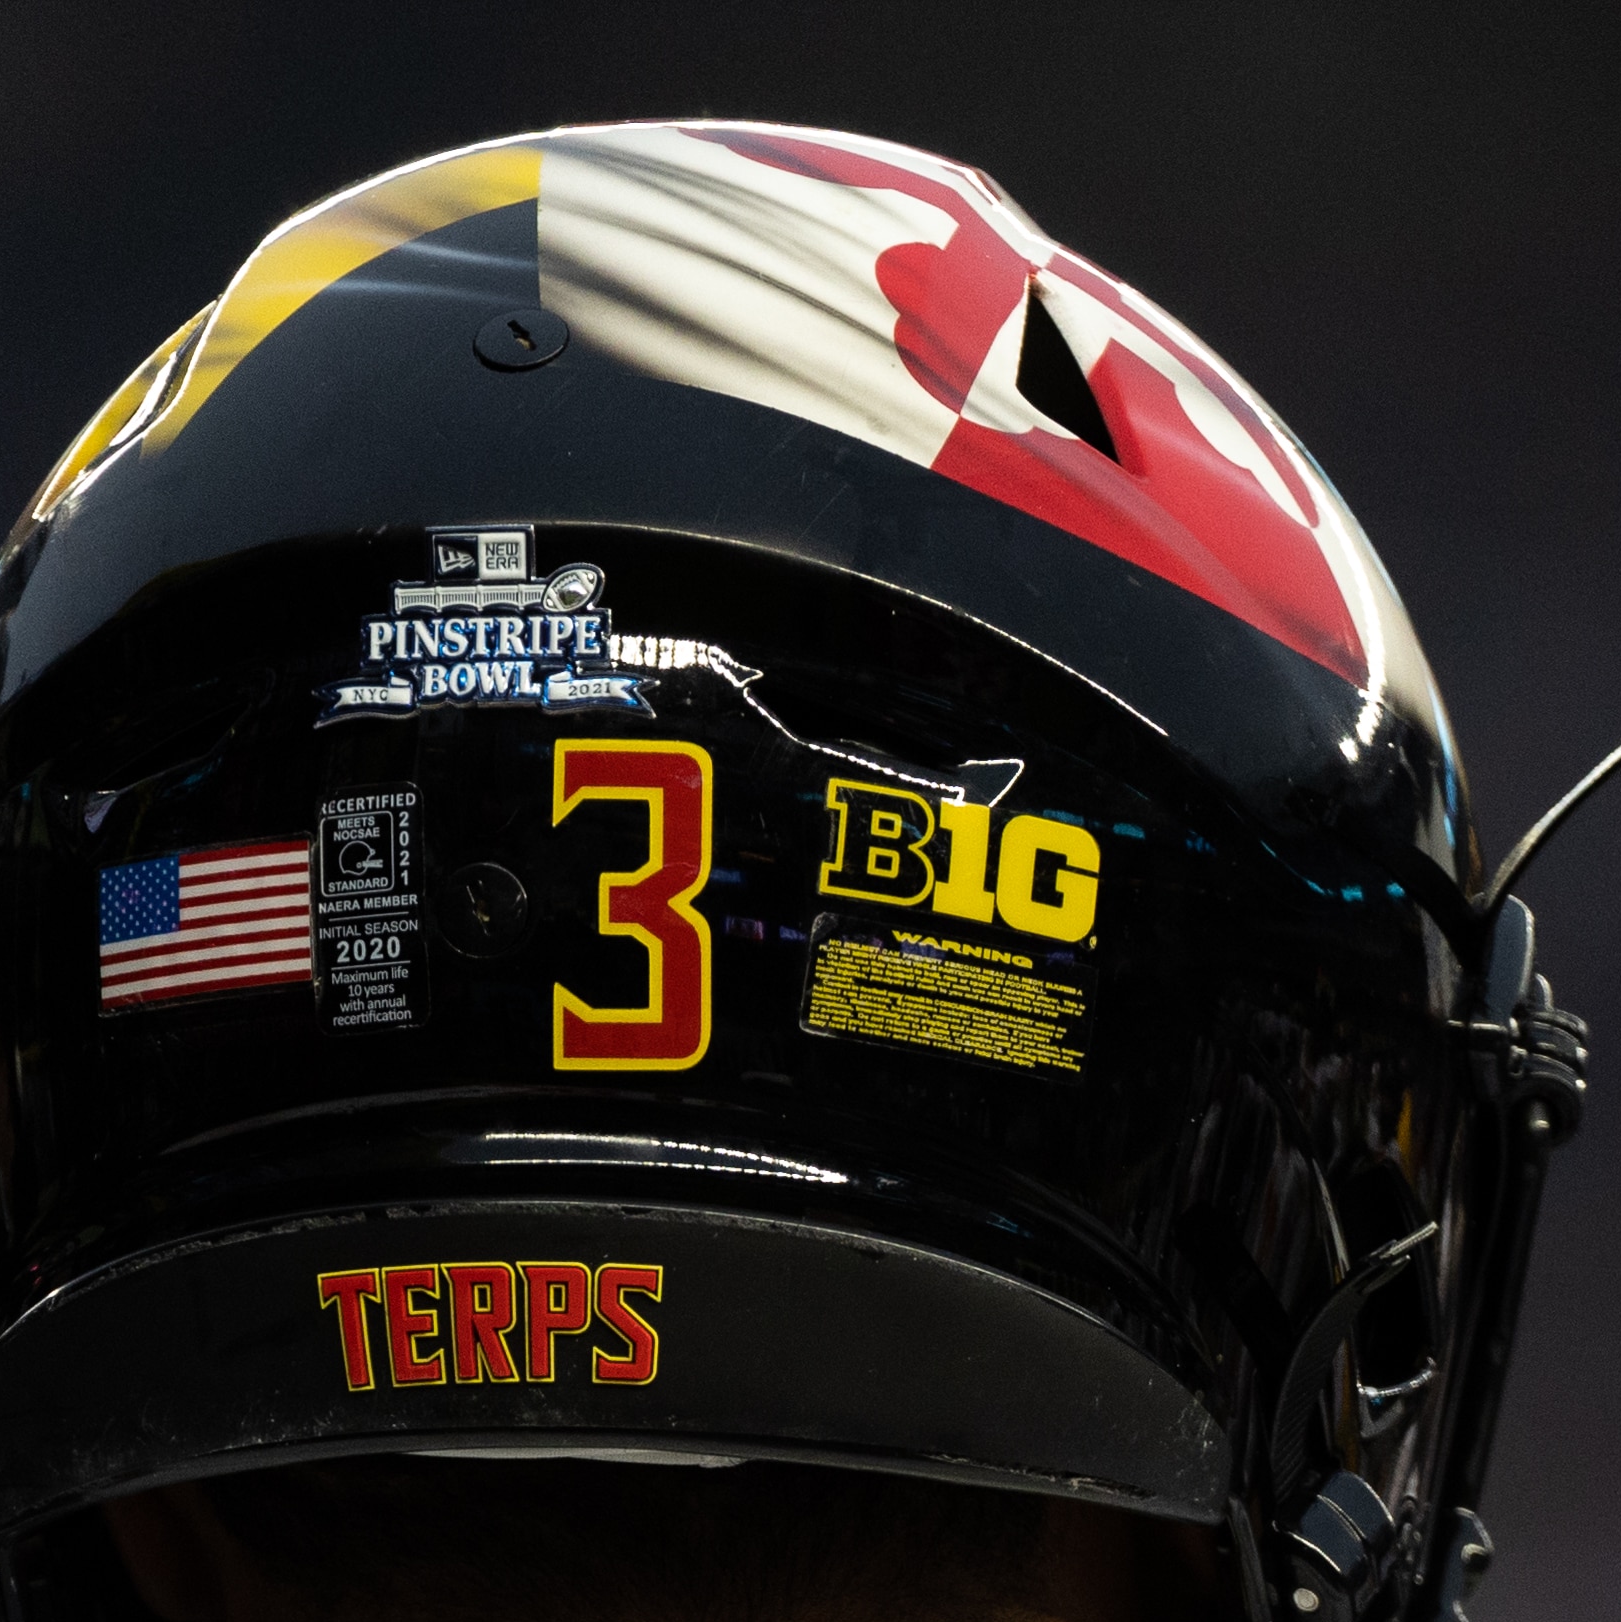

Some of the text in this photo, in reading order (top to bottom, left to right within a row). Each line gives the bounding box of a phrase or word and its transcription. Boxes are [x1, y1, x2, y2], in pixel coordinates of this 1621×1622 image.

[485, 543, 520, 556] NEW
[485, 557, 519, 570] ERA
[368, 615, 601, 661] PINSTRIPE
[423, 660, 542, 698] BOWL
[352, 688, 390, 702] NYC
[567, 682, 613, 698] 2021
[337, 815, 376, 830] MEETS
[333, 826, 381, 842] NOCSAE
[328, 876, 390, 893] STANDARD
[318, 894, 419, 914] NAERA MEMBER
[552, 738, 713, 1072] 3
[319, 919, 419, 940] INITIAL SEASON
[336, 935, 401, 963] 2020
[891, 929, 1034, 970] WARNING
[331, 965, 409, 985] Maximum life
[347, 983, 395, 999] 10 years
[339, 993, 406, 1013] with annual
[333, 1008, 412, 1027] recertification
[316, 1261, 663, 1392] TERPS
